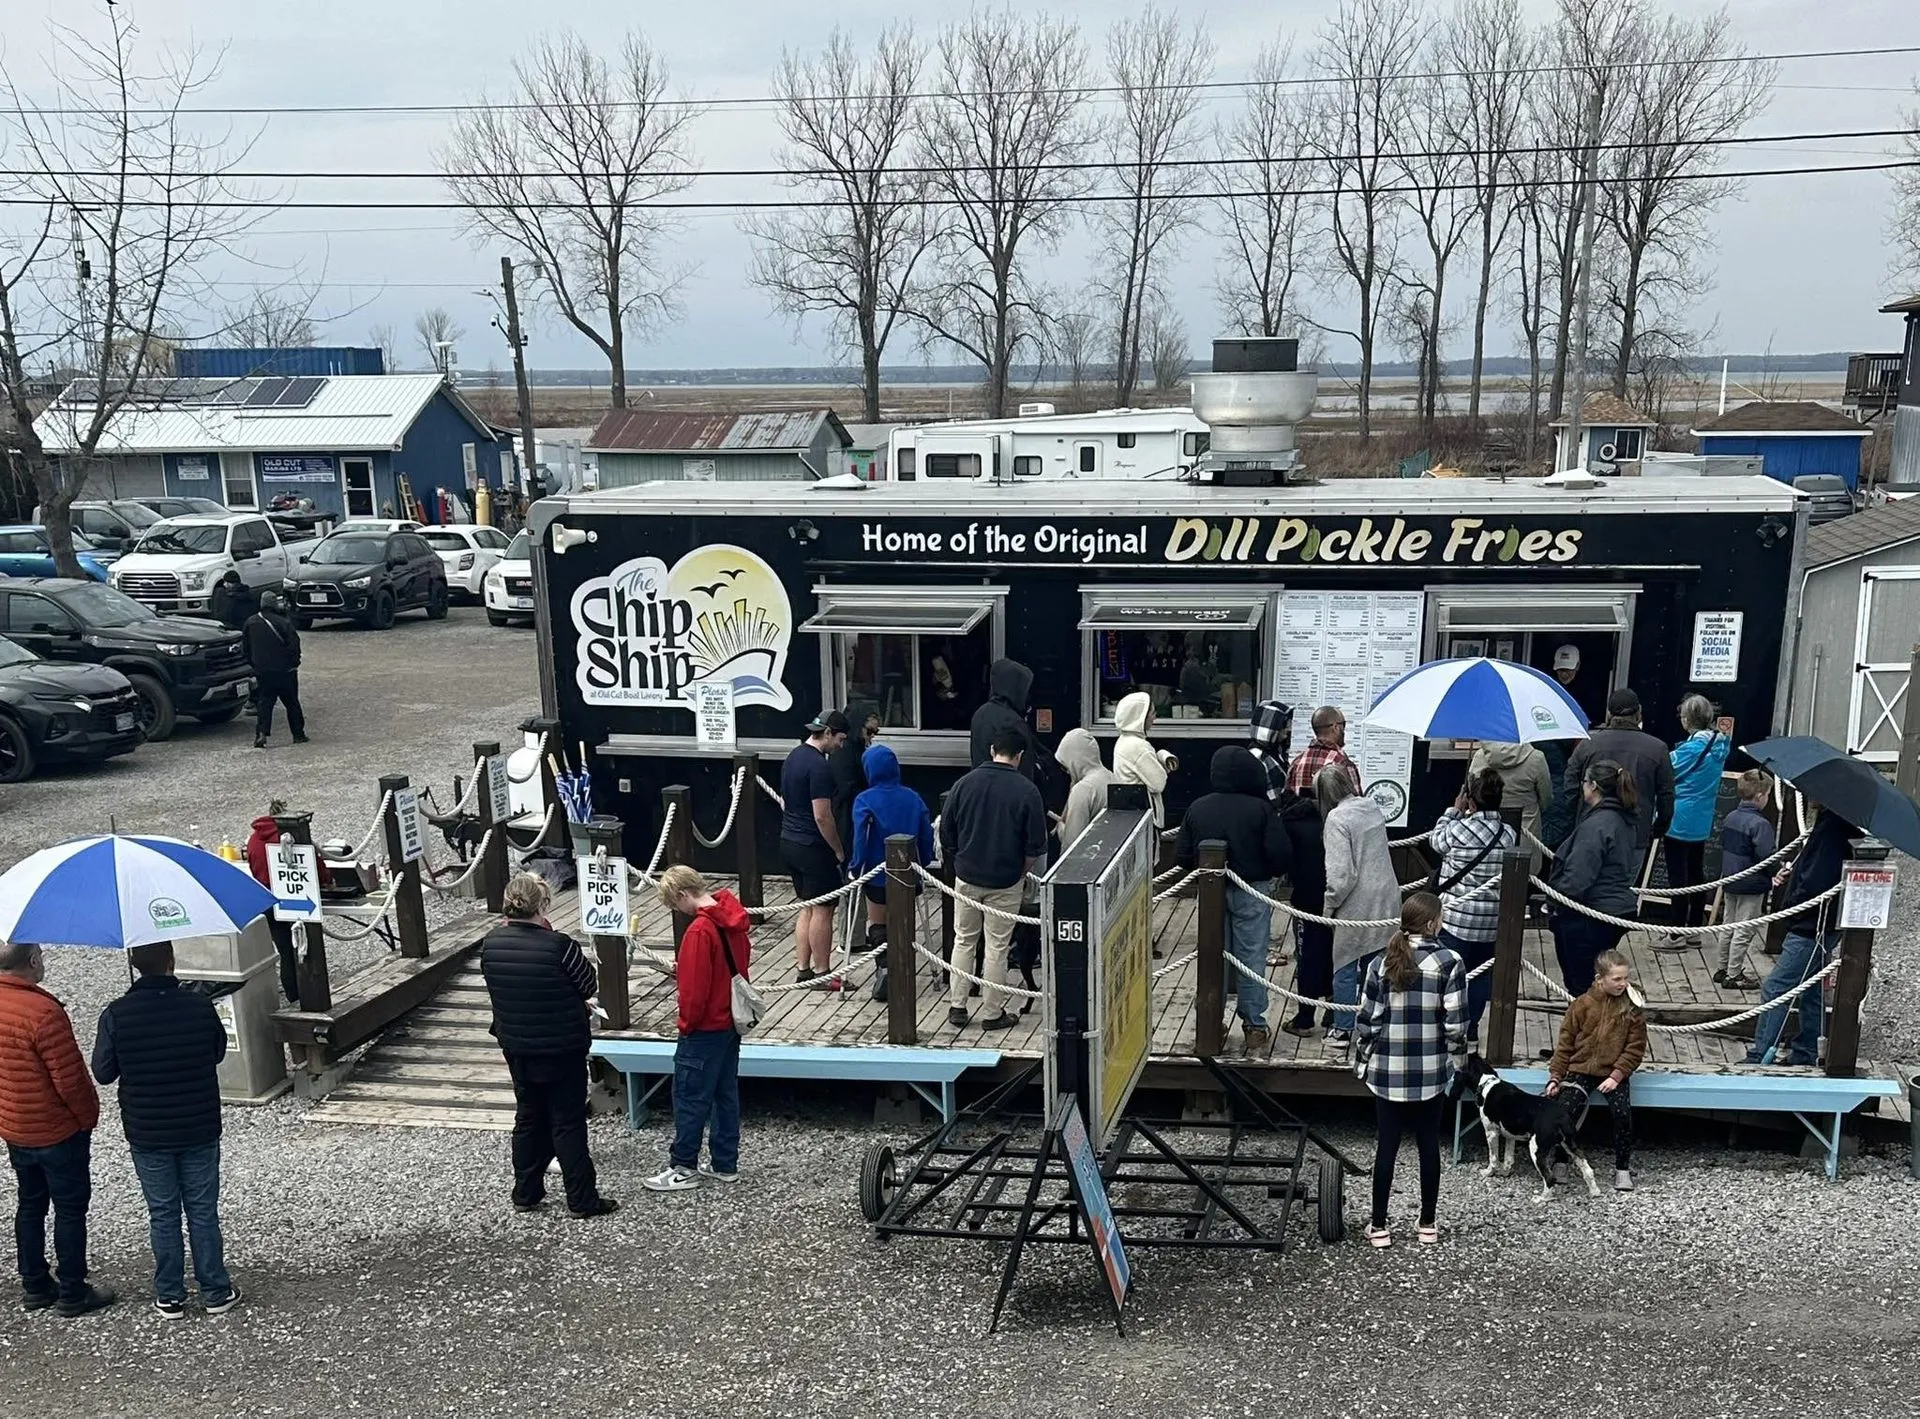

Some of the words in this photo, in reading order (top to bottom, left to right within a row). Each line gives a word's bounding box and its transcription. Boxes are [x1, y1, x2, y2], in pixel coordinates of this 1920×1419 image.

[862, 524, 942, 553] Home
[949, 523, 979, 554] of
[984, 523, 1026, 554] the
[1034, 525, 1147, 563] Original
[617, 567, 658, 597] The
[581, 586, 692, 649] Chip
[1701, 637, 1732, 646] SOCIAL
[1701, 647, 1730, 656] MEDIA
[586, 638, 695, 700] Ship
[597, 690, 610, 698] Old
[624, 691, 640, 699] Boat
[700, 685, 728, 696] Please
[588, 863, 616, 875] EIT
[278, 870, 309, 882] PICK
[1848, 872, 1870, 883] TAKE
[1873, 872, 1892, 883] ONE
[286, 884, 304, 894] UP
[587, 881, 618, 894] PICK
[595, 895, 613, 906] UP
[586, 907, 624, 929] Only
[1060, 921, 1081, 940] 56
